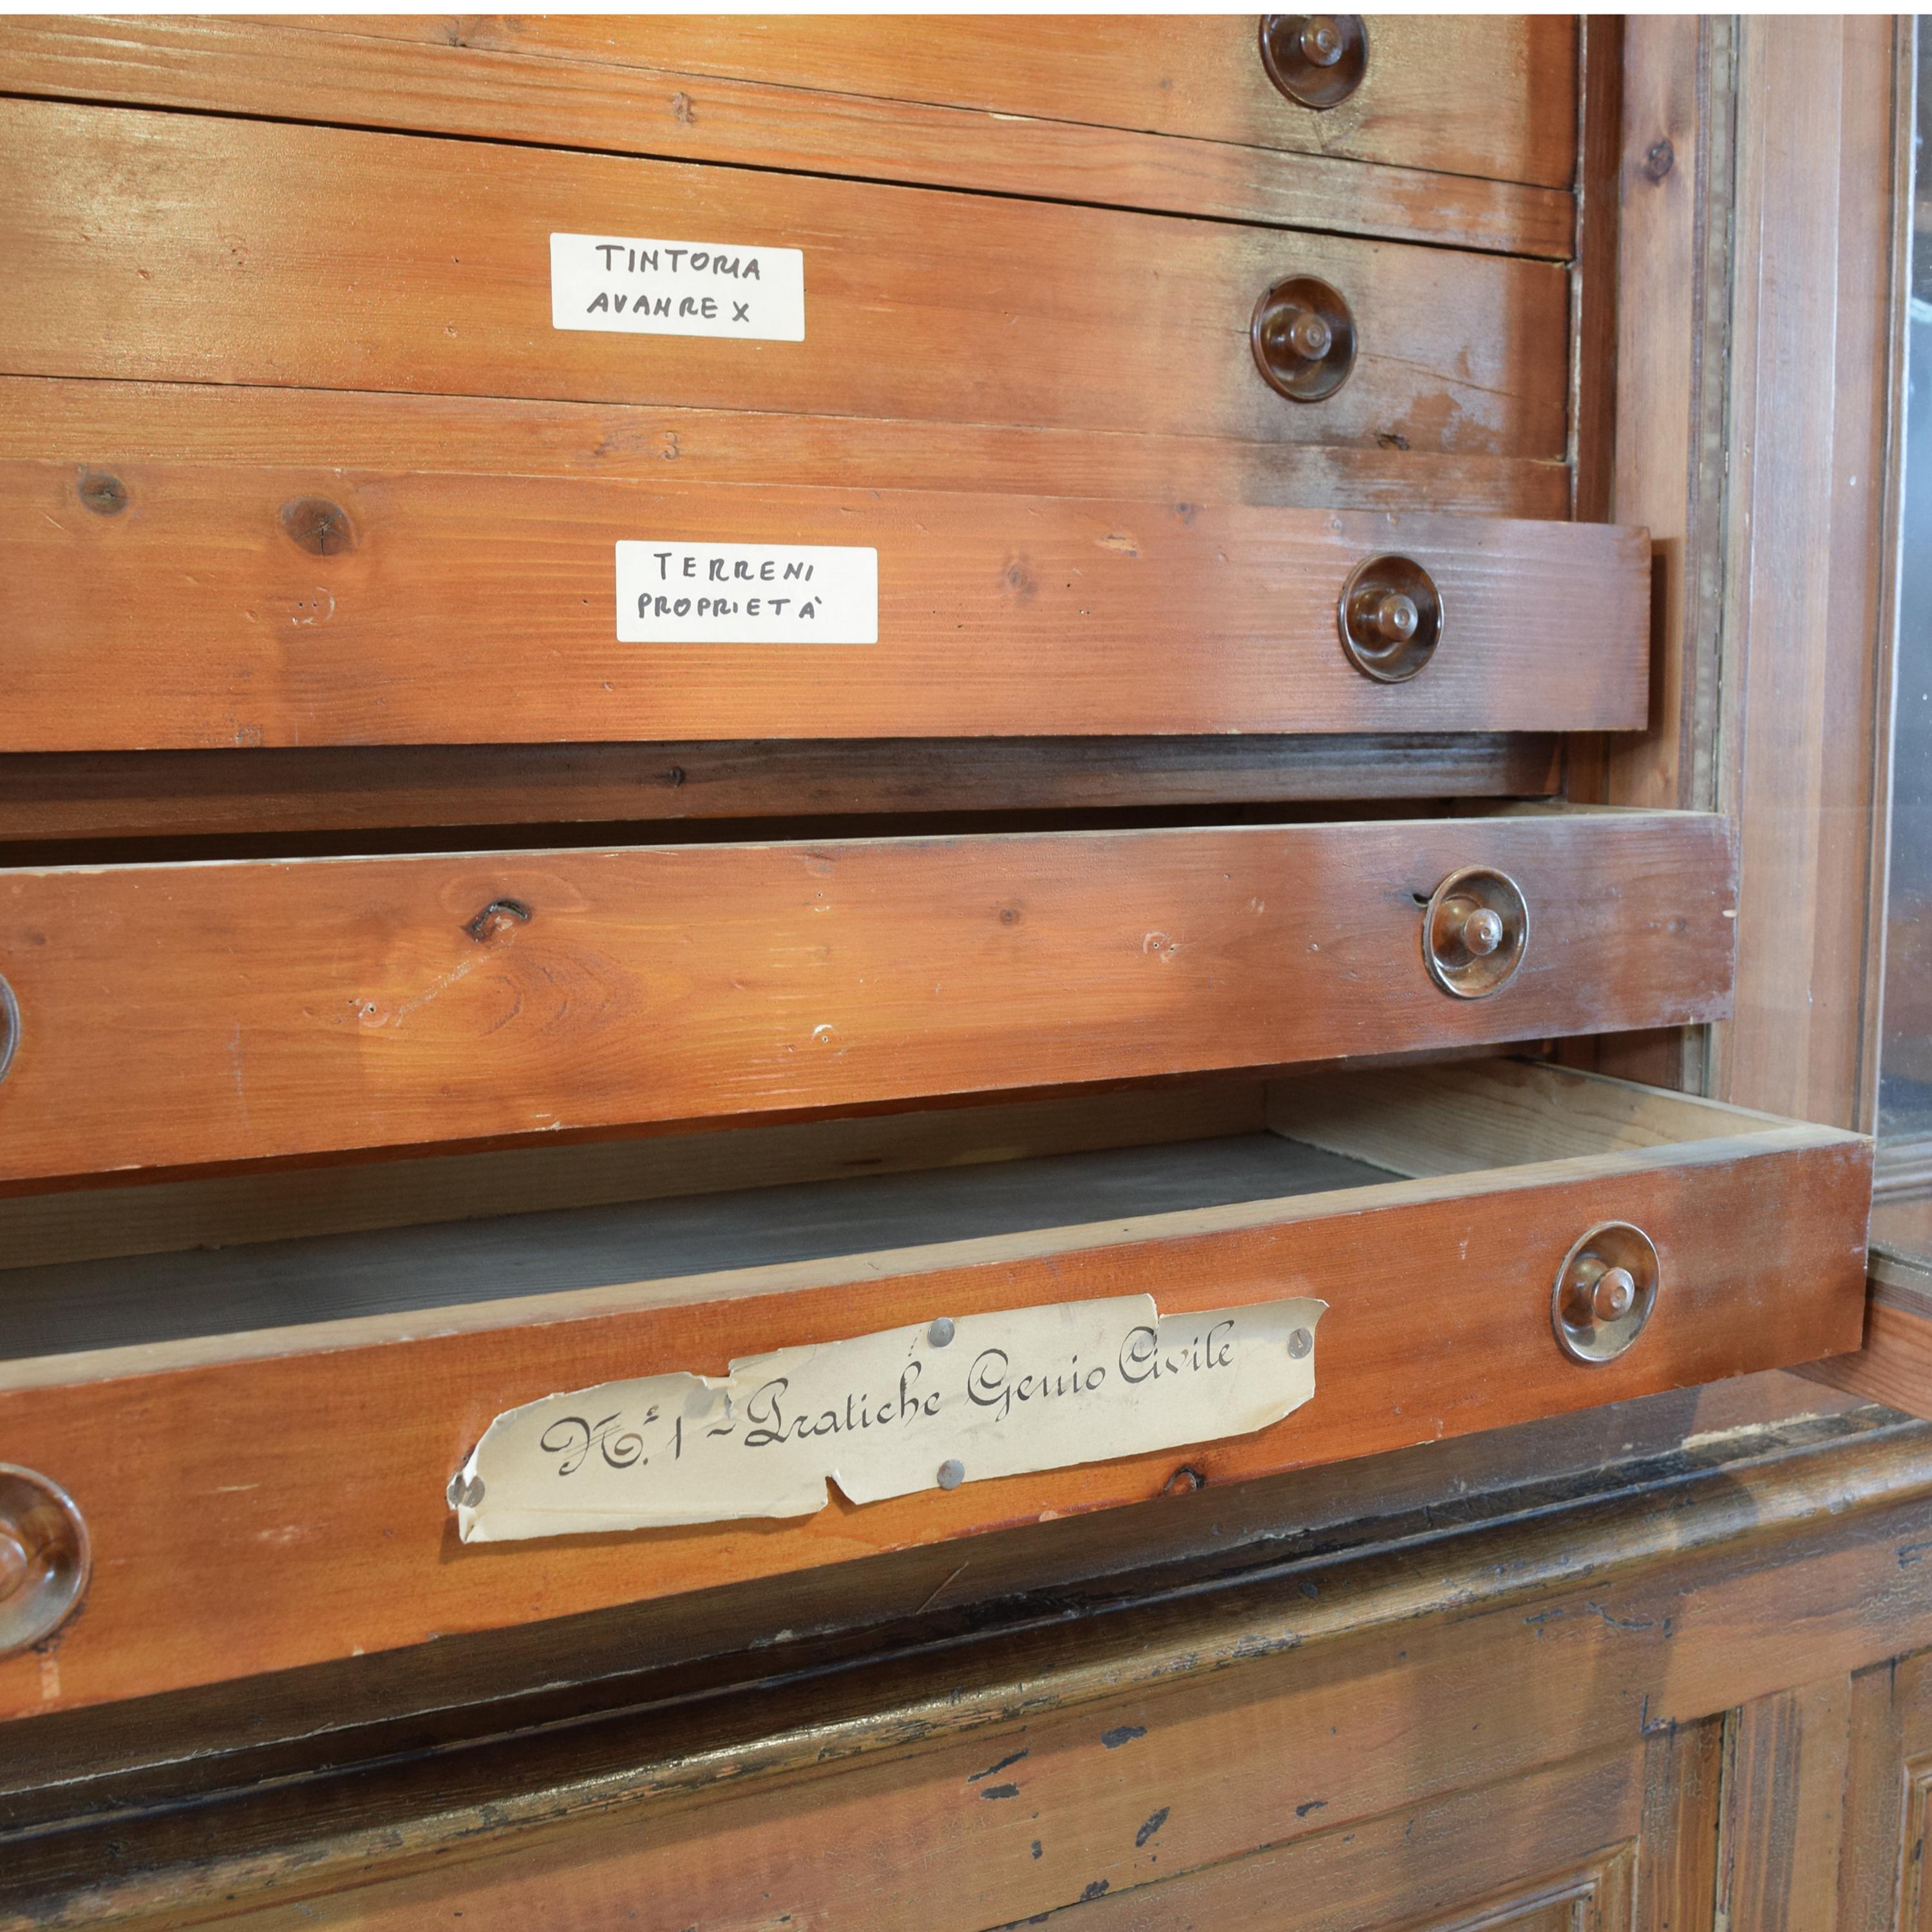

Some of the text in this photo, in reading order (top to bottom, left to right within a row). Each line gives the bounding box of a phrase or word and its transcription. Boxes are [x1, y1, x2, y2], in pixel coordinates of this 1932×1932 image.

[595, 244, 761, 281] TINTORIA
[653, 552, 814, 582] TERRENI
[743, 1360, 941, 1447] Pratiche
[963, 1348, 1106, 1423] Genio
[1119, 1320, 1235, 1384] Civile
